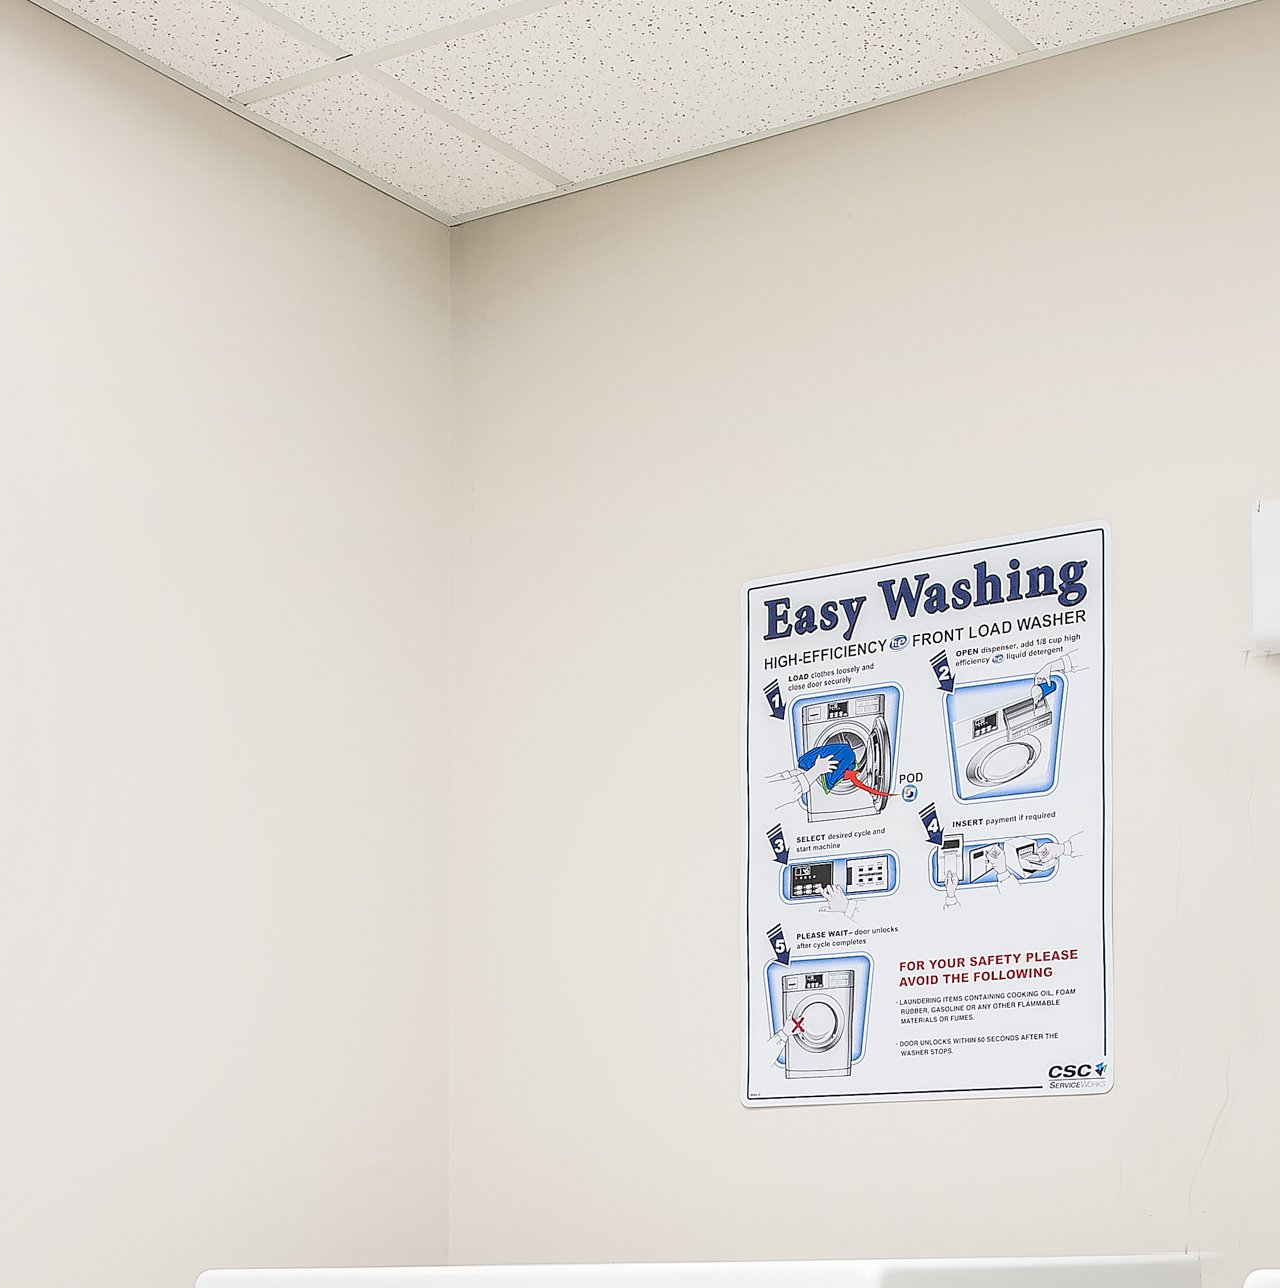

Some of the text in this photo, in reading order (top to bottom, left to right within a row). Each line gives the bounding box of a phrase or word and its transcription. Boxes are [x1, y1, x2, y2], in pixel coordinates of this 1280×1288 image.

[764, 559, 1088, 641] Easy Washing
[765, 639, 887, 670] HIGH-EFFICIENCY
[913, 628, 964, 647] FRONT
[970, 621, 1011, 638] LOAD
[1017, 610, 1086, 631] WASHER
[789, 674, 808, 682] LOAD
[811, 670, 834, 678] clothes
[837, 666, 860, 674] loosely
[939, 666, 950, 680] 2
[824, 676, 852, 686] securely
[772, 691, 783, 709] 1
[900, 772, 923, 784] POD
[928, 818, 940, 833] 4
[953, 818, 983, 827] INSERT
[986, 816, 1016, 826] payment
[1026, 811, 1055, 820] required
[774, 838, 784, 853] 3
[776, 939, 786, 954] 5
[900, 950, 1078, 971] FOR YOUR SAFETY PLEASE
[900, 967, 1052, 986] AVOID THE FOLLOWING
[1049, 1064, 1092, 1078] CSC
